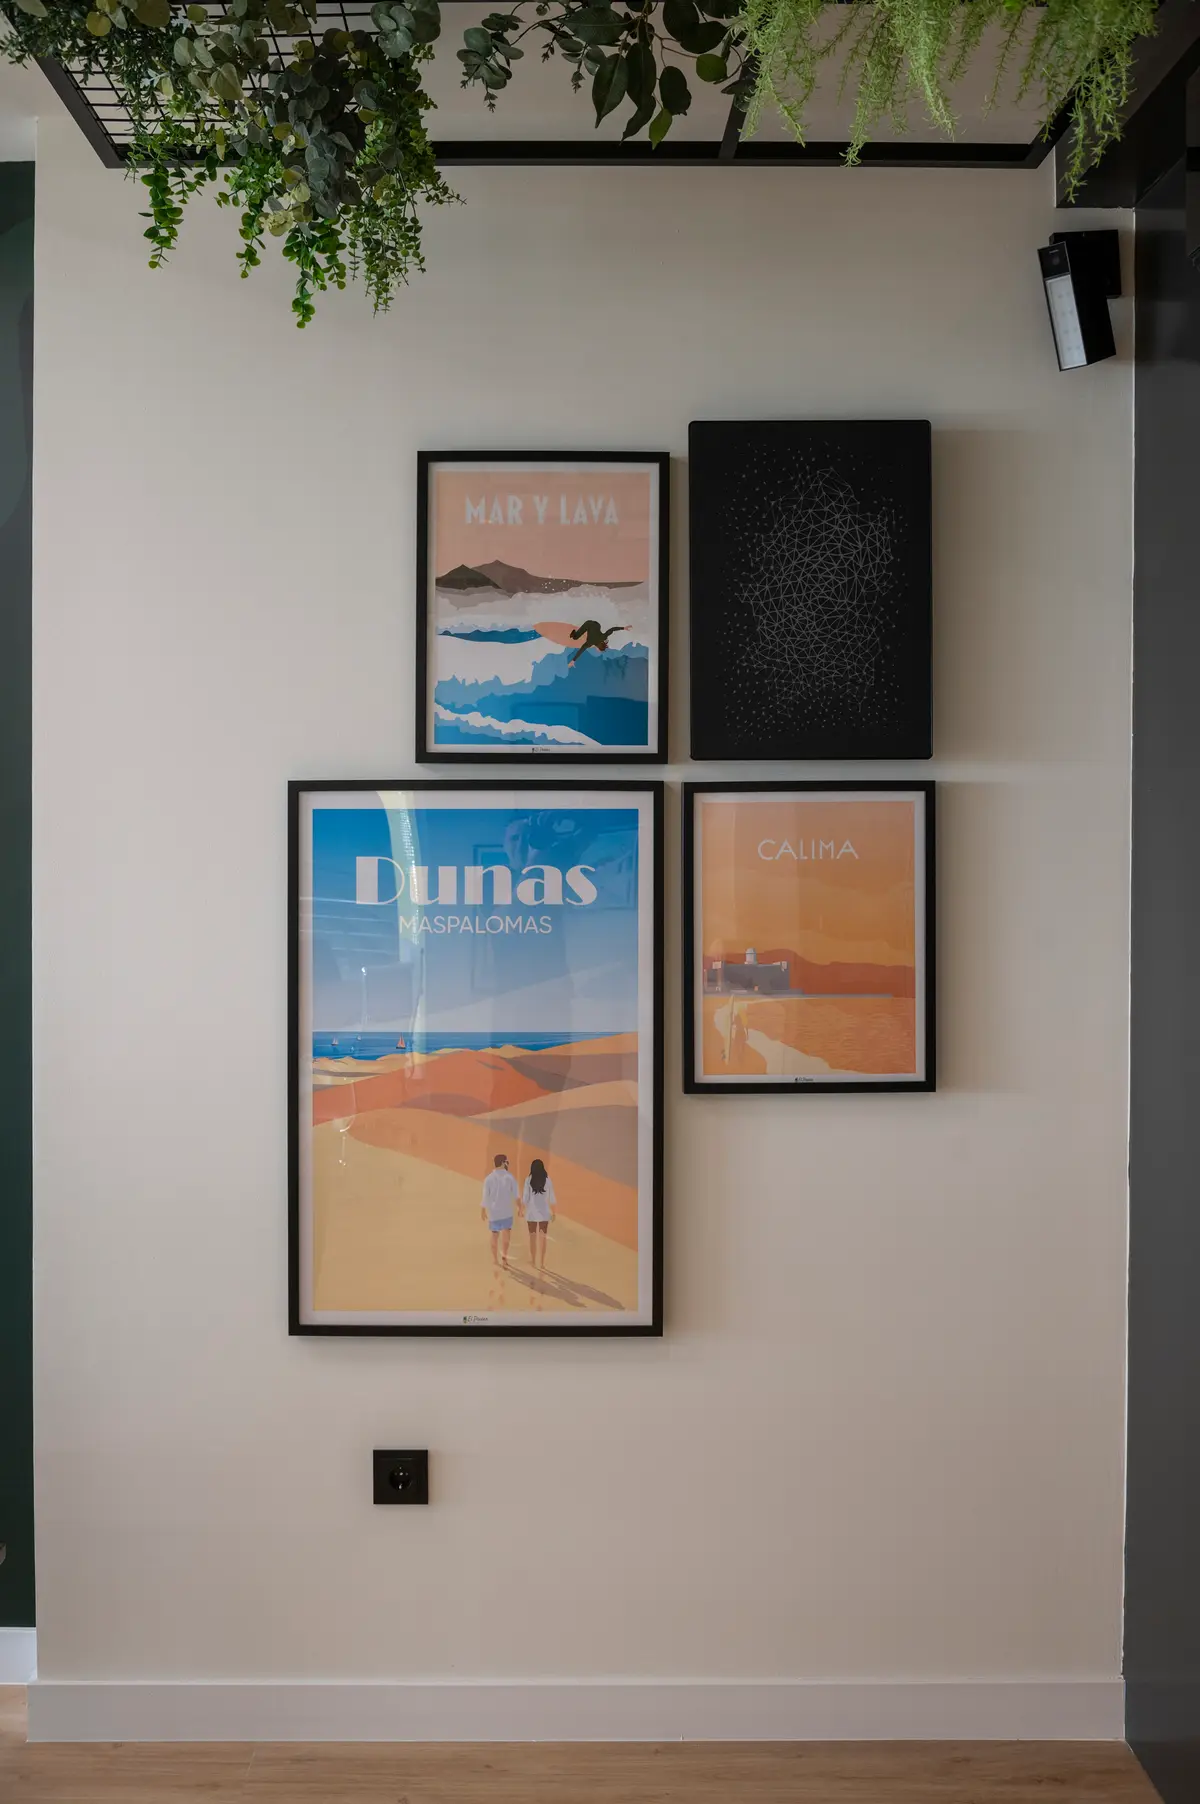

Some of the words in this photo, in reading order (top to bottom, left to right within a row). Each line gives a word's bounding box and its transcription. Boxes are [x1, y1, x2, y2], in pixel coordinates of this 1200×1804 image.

[464, 493, 524, 525] MAR
[533, 494, 550, 525] Y
[560, 493, 620, 525] LAVA
[757, 838, 859, 861] CALIMA
[355, 855, 599, 906] Dunas
[399, 915, 553, 935] MASPALOMAS
